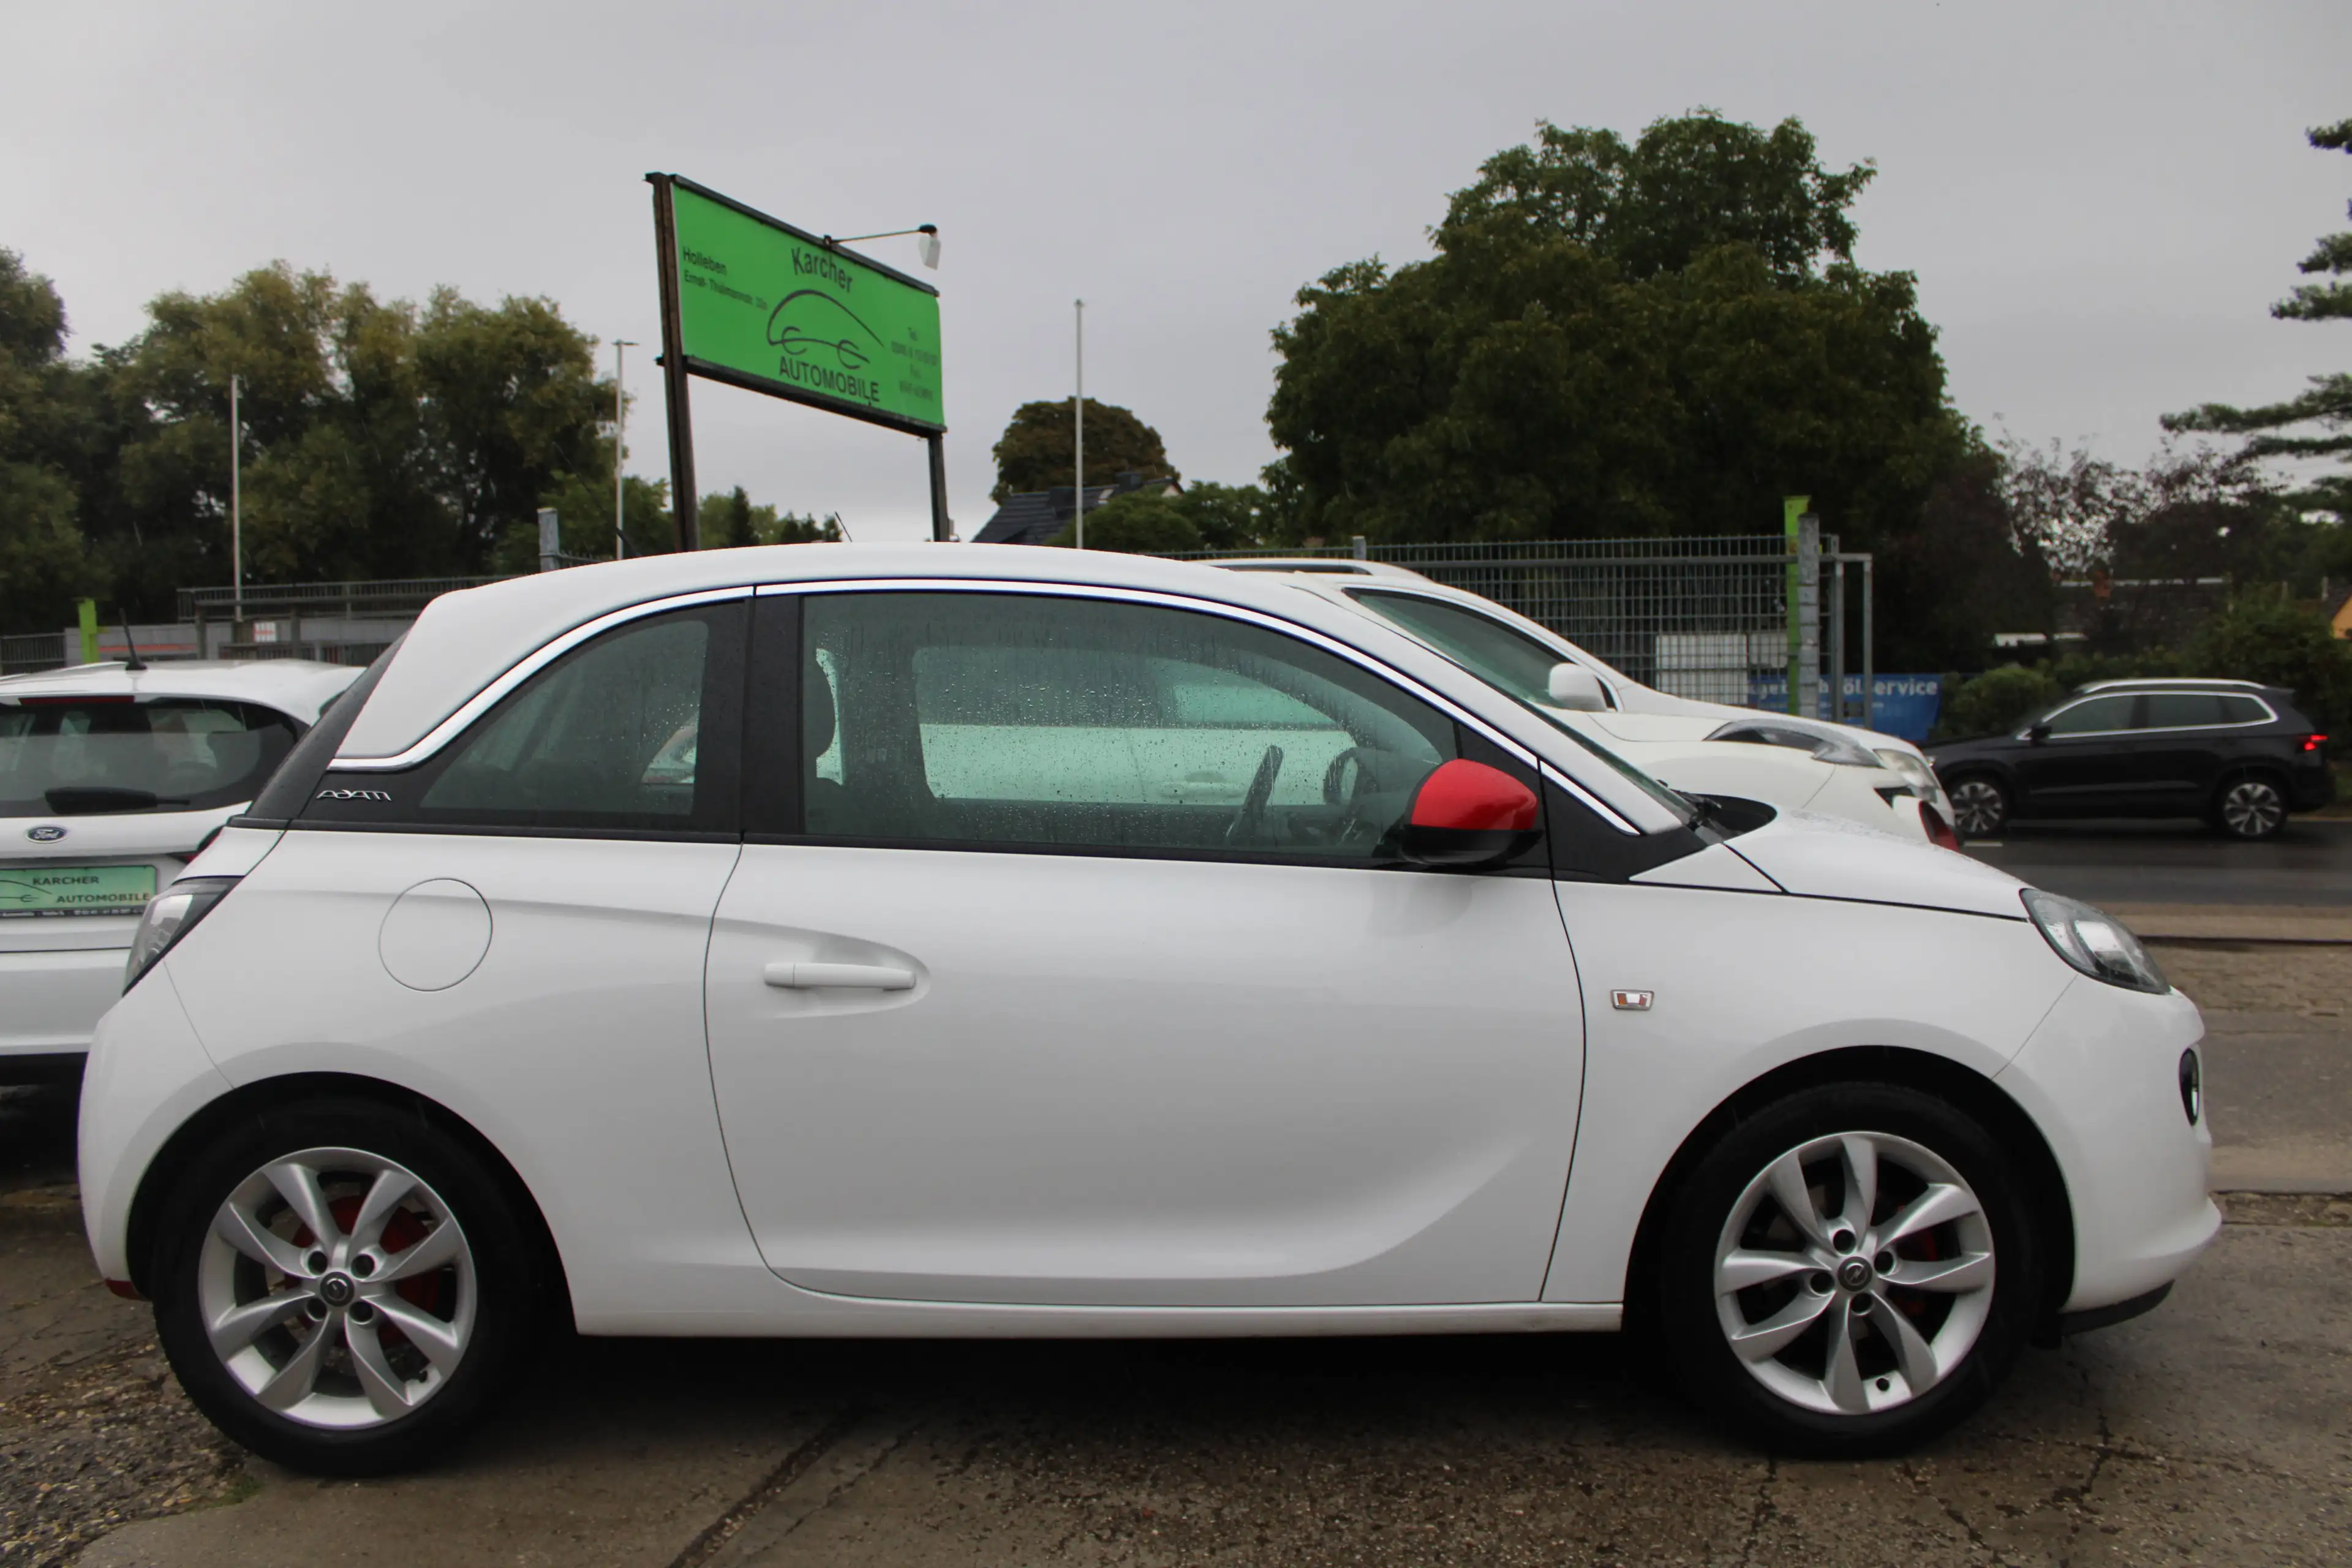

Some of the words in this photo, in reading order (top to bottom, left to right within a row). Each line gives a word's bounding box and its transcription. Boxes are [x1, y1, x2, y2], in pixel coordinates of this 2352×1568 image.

[683, 246, 728, 276] Holleben
[791, 247, 853, 293] Karcher
[780, 356, 880, 402] AUTOMOBILE
[32, 876, 100, 886] KARCHER
[56, 893, 151, 903] AUTOMOBILE
